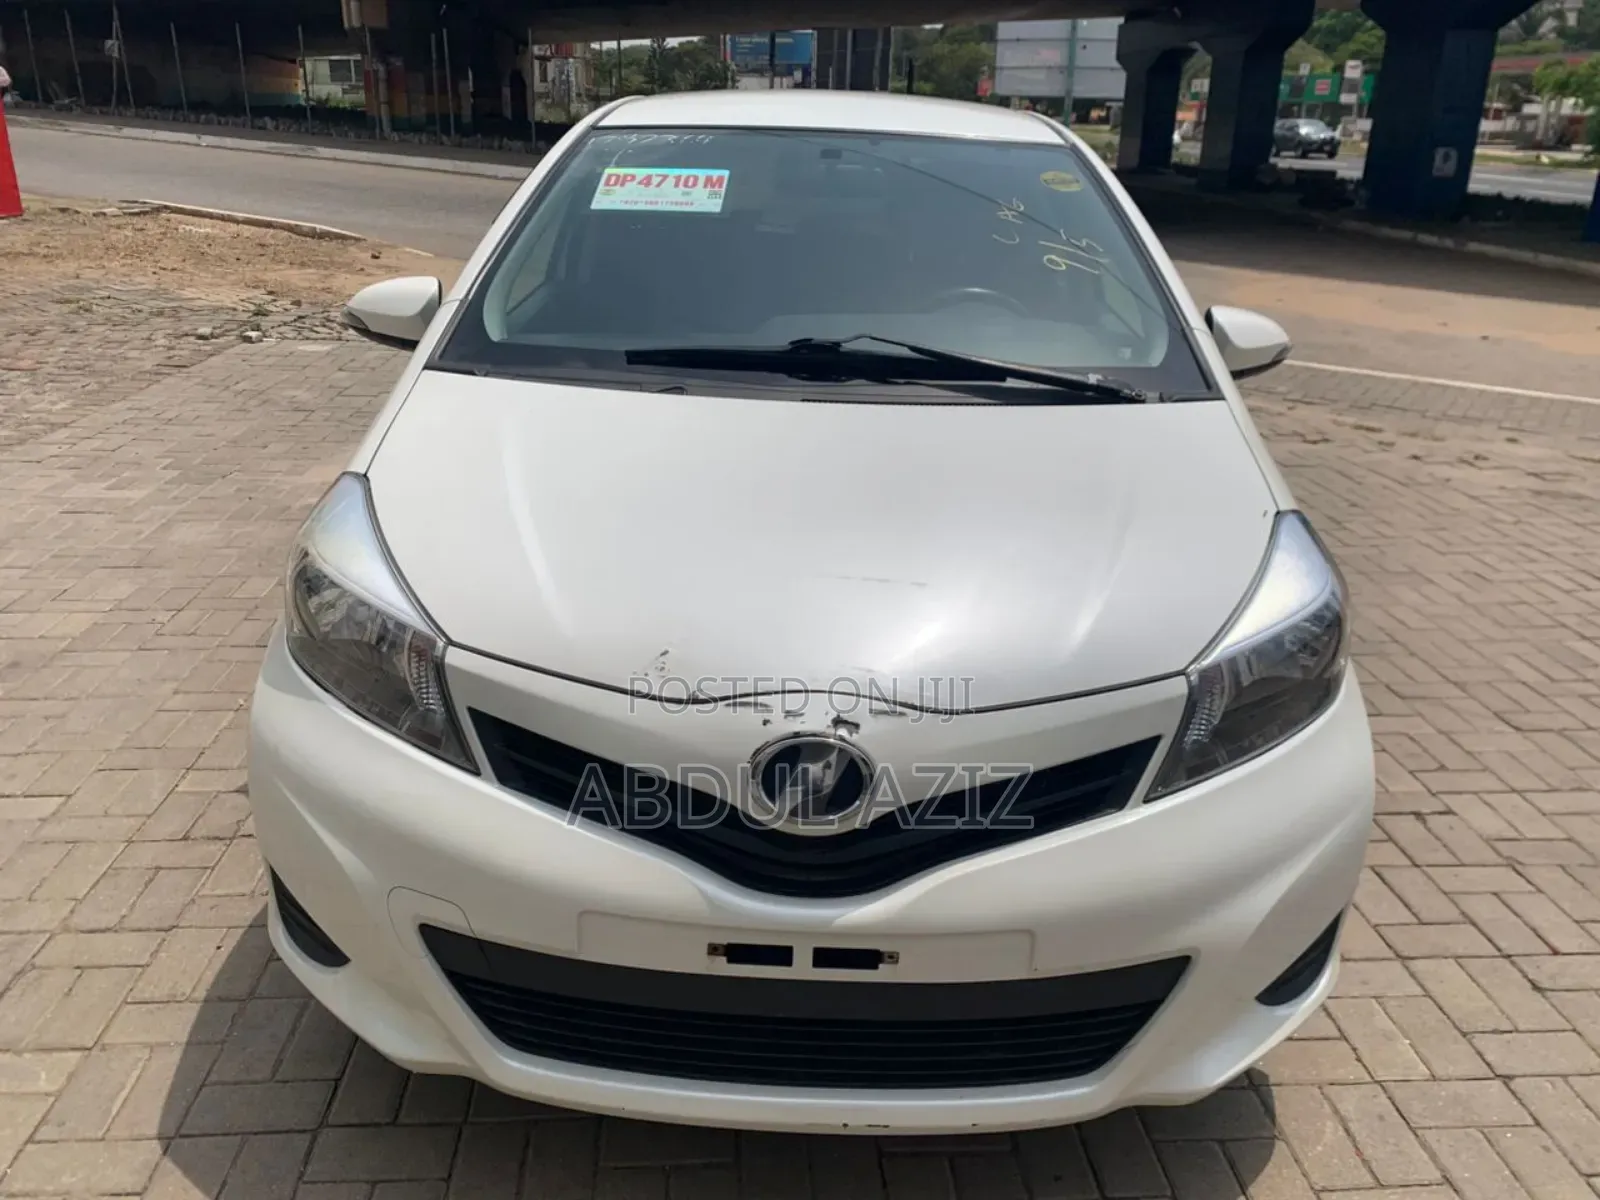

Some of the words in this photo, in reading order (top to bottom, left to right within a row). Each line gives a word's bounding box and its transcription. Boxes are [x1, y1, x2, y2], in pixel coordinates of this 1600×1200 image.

[603, 174, 637, 188] DP
[636, 174, 700, 189] 4710
[703, 175, 726, 190] M
